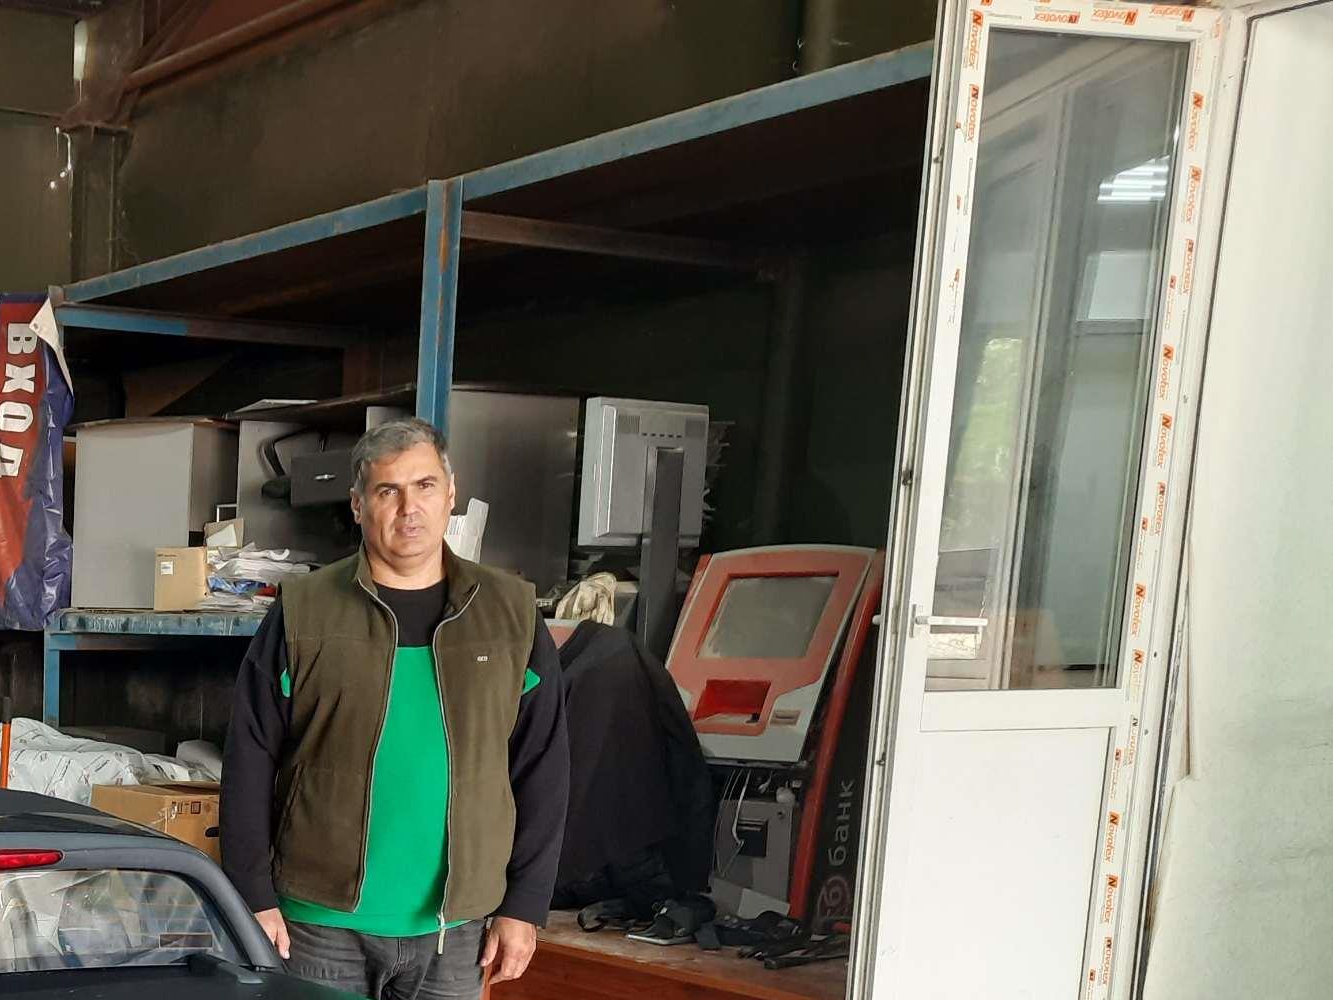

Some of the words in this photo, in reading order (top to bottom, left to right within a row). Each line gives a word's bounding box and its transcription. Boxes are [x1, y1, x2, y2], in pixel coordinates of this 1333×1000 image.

[969, 10, 983, 67] Novotex
[1034, 12, 1082, 24] Novotex
[968, 84, 979, 141] Novotex
[1158, 345, 1174, 400] Novotex
[1157, 413, 1172, 468] Novotex
[1131, 584, 1146, 636] Novotex
[828, 779, 855, 867] банк
[1105, 811, 1119, 862] Novotex
[1104, 874, 1119, 924] Novotex
